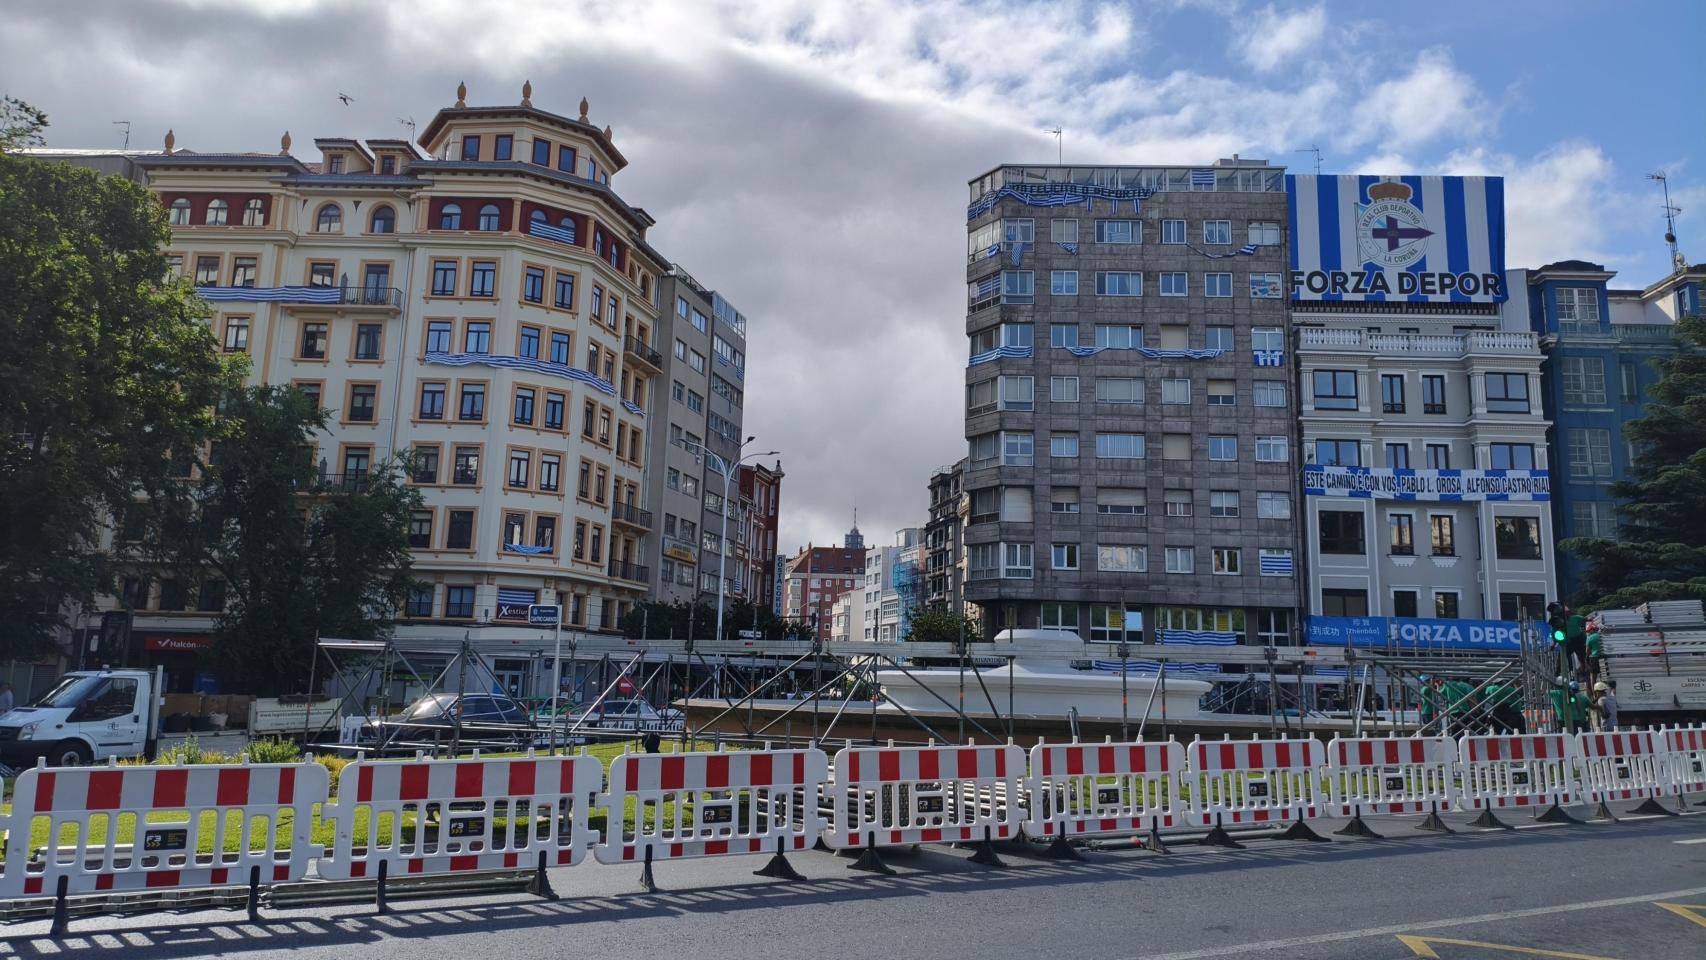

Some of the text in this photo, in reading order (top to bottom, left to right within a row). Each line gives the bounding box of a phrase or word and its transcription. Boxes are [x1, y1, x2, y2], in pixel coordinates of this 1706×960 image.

[1362, 204, 1421, 228] REAL CLUB DEPORTIVO
[1384, 255, 1392, 263] LA
[1290, 270, 1501, 296] FORZA DEPOR
[1306, 472, 1324, 488] ESTE
[1364, 475, 1380, 491] CON
[1381, 475, 1400, 493] VOS,
[1401, 476, 1425, 493] PABLO
[1427, 477, 1434, 493] L.
[1436, 477, 1464, 495] OROSA,
[1467, 477, 1500, 493] ALFONSO
[1502, 477, 1532, 493] CASTRO
[1533, 477, 1550, 493] RIAL
[1390, 623, 1463, 642] FORZA
[170, 640, 196, 648] Halcón
